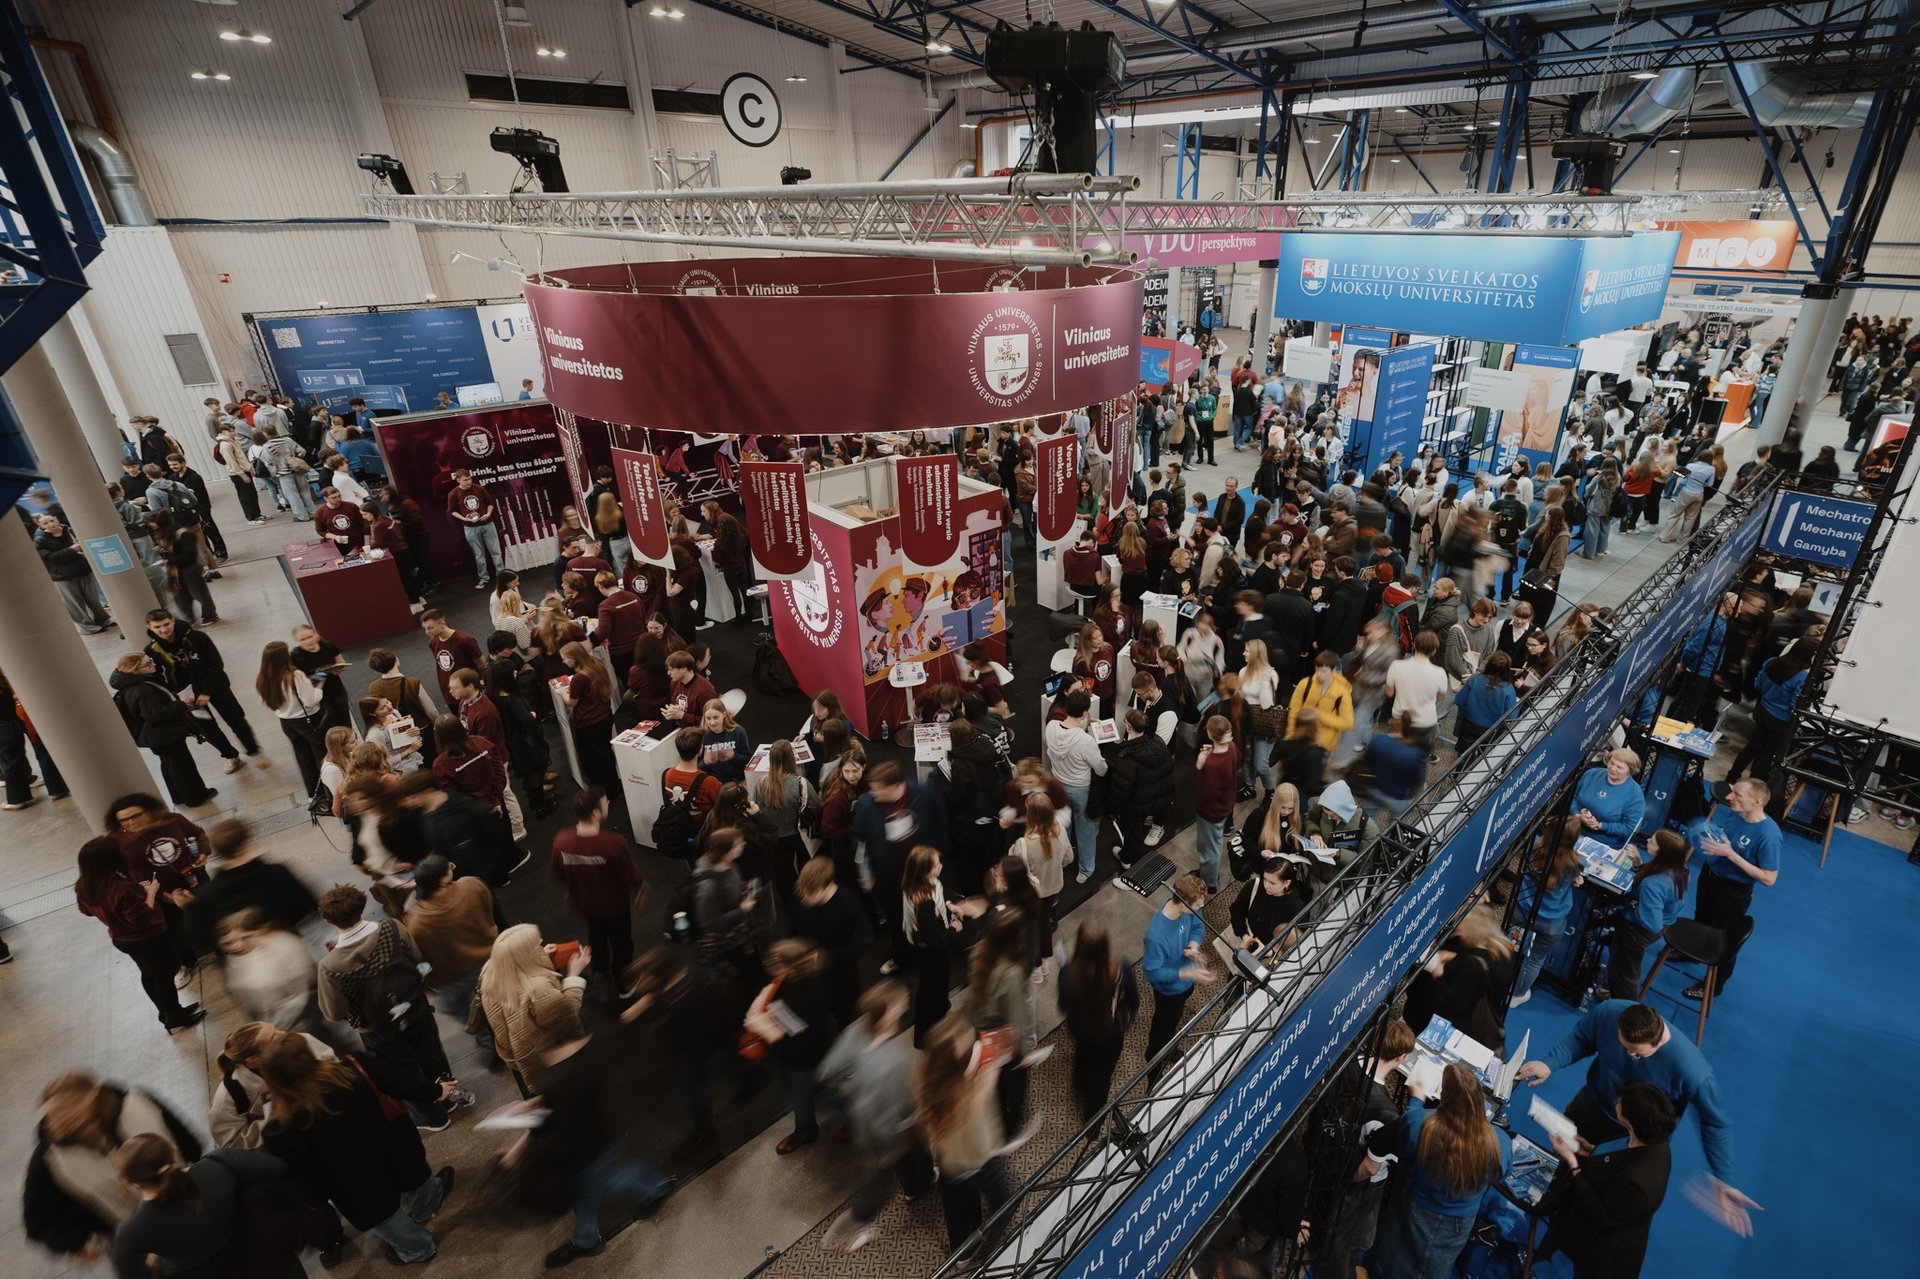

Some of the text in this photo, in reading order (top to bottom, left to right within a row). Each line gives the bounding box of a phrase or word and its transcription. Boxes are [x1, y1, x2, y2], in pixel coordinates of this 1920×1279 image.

[739, 93, 765, 128] C
[1142, 218, 1195, 254] VDU
[1202, 236, 1256, 253] perspektyvos
[745, 283, 800, 296] Vilniaus
[1333, 263, 1540, 290] LIETUVOS SVEIKATOS
[1598, 262, 1667, 287] LIETUVOS SVEIKATOS
[1329, 281, 1536, 310] MOKSLŲ UNIVERSITETAS
[1593, 280, 1663, 305] MOKSLŲ UNIVERSITETAS
[1734, 306, 1774, 314] AKADEMIJA
[543, 326, 585, 351] Vilniaus
[967, 306, 1043, 355] VILNIAUS UNIVERSITETAS
[998, 323, 1015, 332] 1579
[1063, 326, 1111, 346] Vilniaus
[550, 353, 624, 381] universitetas
[1064, 344, 1129, 370] universitetas
[968, 361, 1043, 408] UNIVERSITAS VILNENSIS
[503, 427, 536, 437] Vilniaus
[506, 432, 556, 445] universitetas
[450, 465, 496, 481] Pirink,
[497, 462, 515, 472] kas
[516, 461, 532, 469] tau
[533, 457, 553, 467] šiuo
[478, 465, 558, 487] yra svarbiausia?
[642, 463, 654, 500] Teisės
[1056, 446, 1064, 494] mokykla
[632, 461, 649, 522] fakultetas
[770, 472, 781, 511] institutas
[925, 465, 934, 506] fakultetas
[934, 464, 943, 526] administravimo
[943, 463, 951, 510] Ekonomikos
[779, 480, 791, 515] politikos
[785, 515, 794, 543] mokslų
[788, 472, 804, 557] Tarptautinių santykių
[1806, 504, 1871, 525] Mechatro
[945, 517, 953, 541] verslo
[1800, 522, 1865, 542] Mechanik
[1793, 538, 1847, 558] Gamyba
[820, 607, 844, 649] VILNENSIS
[1493, 802, 1517, 833] Verslo
[1387, 853, 1454, 935] Laivavedyba
[1328, 883, 1446, 1026] Jūrinės vėjo jėgainės
[1304, 1031, 1339, 1079] Laivų
[1342, 973, 1390, 1033] elektros
[1389, 909, 1440, 984] įrenginiai
[1111, 1098, 1234, 1248] energetiniai
[1238, 1009, 1313, 1108] įrenginiai
[1215, 1101, 1283, 1190] logistika
[1118, 1053, 1299, 1275] ir laivybos valdymas
